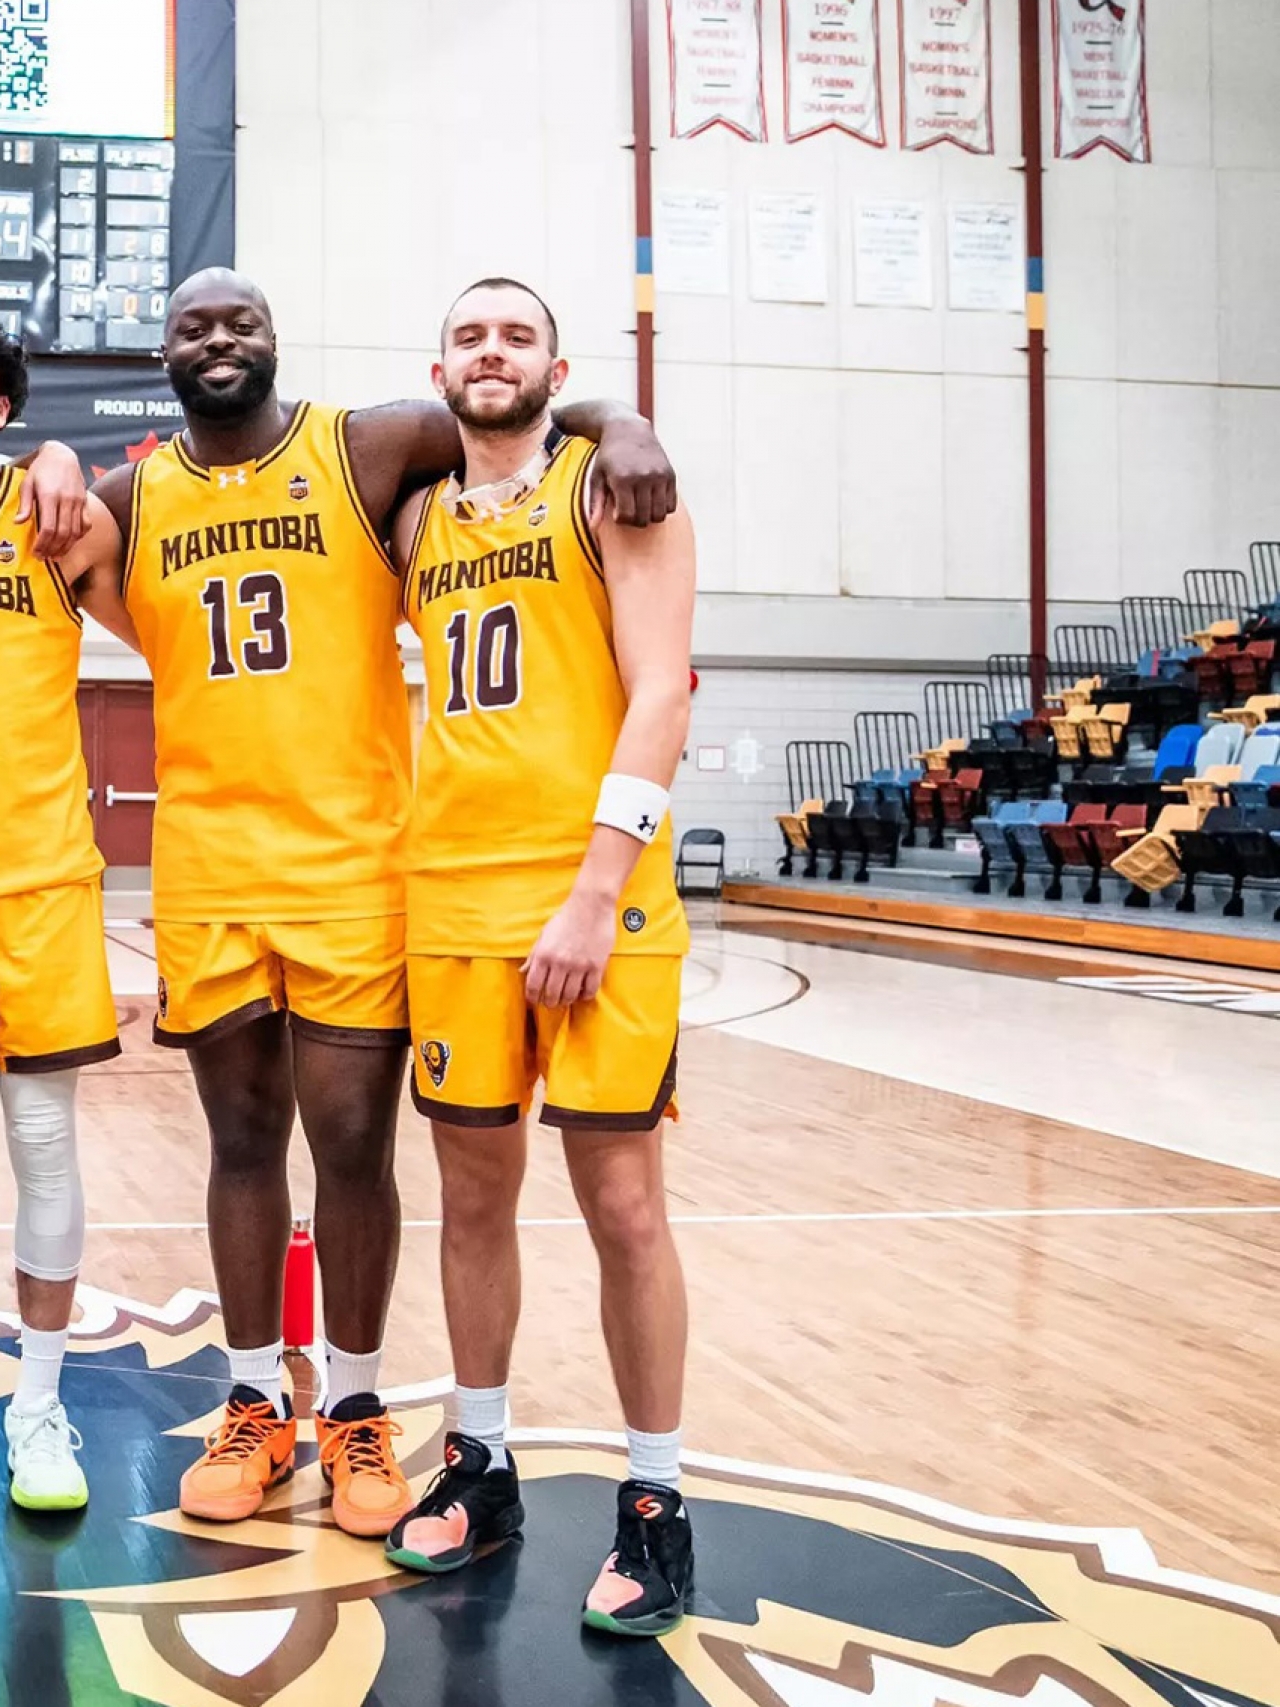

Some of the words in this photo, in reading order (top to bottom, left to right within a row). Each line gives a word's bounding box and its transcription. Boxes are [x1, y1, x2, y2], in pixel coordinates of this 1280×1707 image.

[151, 264, 165, 286] 5
[94, 400, 144, 416] PROUD
[146, 402, 185, 417] PART
[160, 512, 328, 580] MANITOBA
[418, 536, 559, 614] MANITOBA
[198, 570, 291, 681] 13
[443, 600, 521, 718] 10
